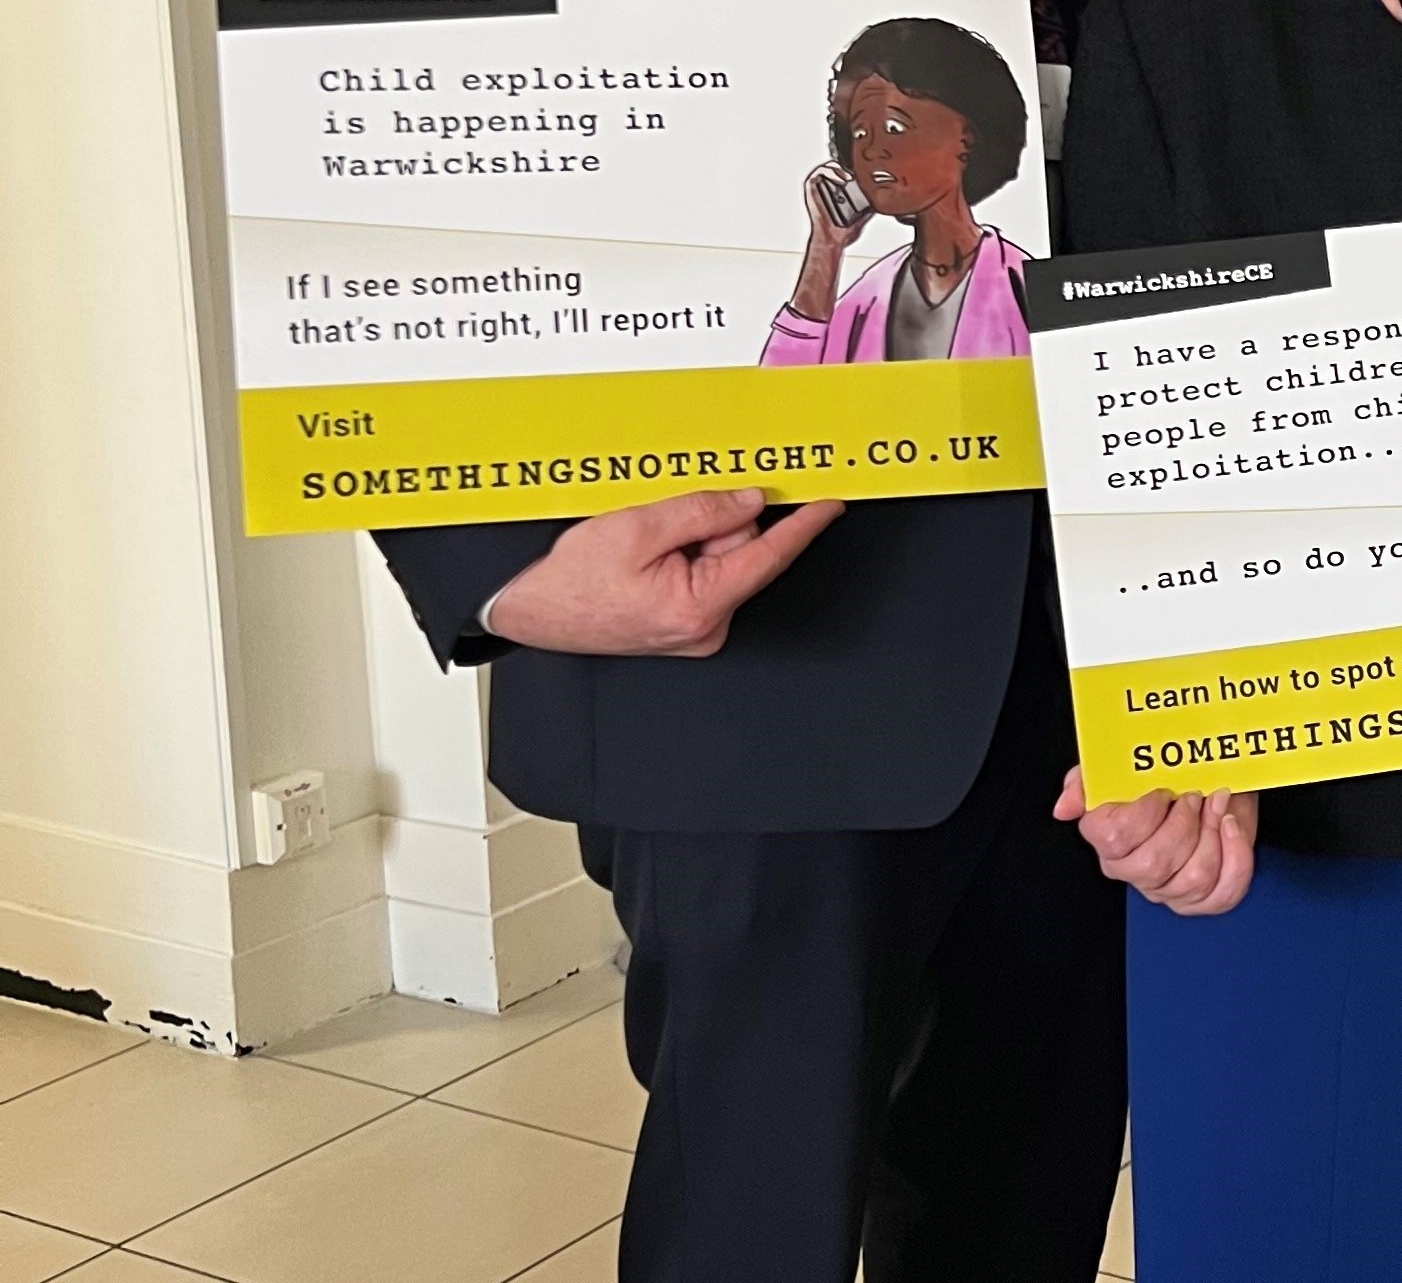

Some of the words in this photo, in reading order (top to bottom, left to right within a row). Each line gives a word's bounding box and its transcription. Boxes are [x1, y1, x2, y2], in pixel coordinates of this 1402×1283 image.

[318, 67, 437, 93] Child
[461, 65, 730, 98] exploitation
[322, 109, 367, 135] is
[391, 107, 599, 140] happening
[624, 106, 666, 131] in
[321, 148, 601, 178] Warwickshire
[286, 272, 312, 301] If
[321, 274, 331, 299] I
[342, 278, 401, 299] see
[410, 265, 582, 297] something
[1061, 262, 1274, 301] #WarwickshireCE
[392, 316, 447, 341] not
[456, 310, 542, 344] right,
[600, 306, 695, 338] report
[704, 302, 726, 328] it
[1092, 351, 1110, 372] I
[1133, 344, 1217, 368] have
[1240, 339, 1259, 356] a
[1096, 376, 1243, 418] protect
[296, 409, 376, 439] Visit
[1101, 418, 1227, 457] people
[1251, 409, 1333, 433] from
[301, 435, 1000, 500] SOMETHINGSNOTRIGHT.CO.UK
[1119, 560, 1219, 594] ..and
[1242, 559, 1282, 579] so
[1305, 547, 1345, 570] do
[1125, 685, 1210, 713] Learn
[1218, 675, 1280, 701] how
[1288, 669, 1320, 691] to
[1330, 655, 1397, 690] spot
